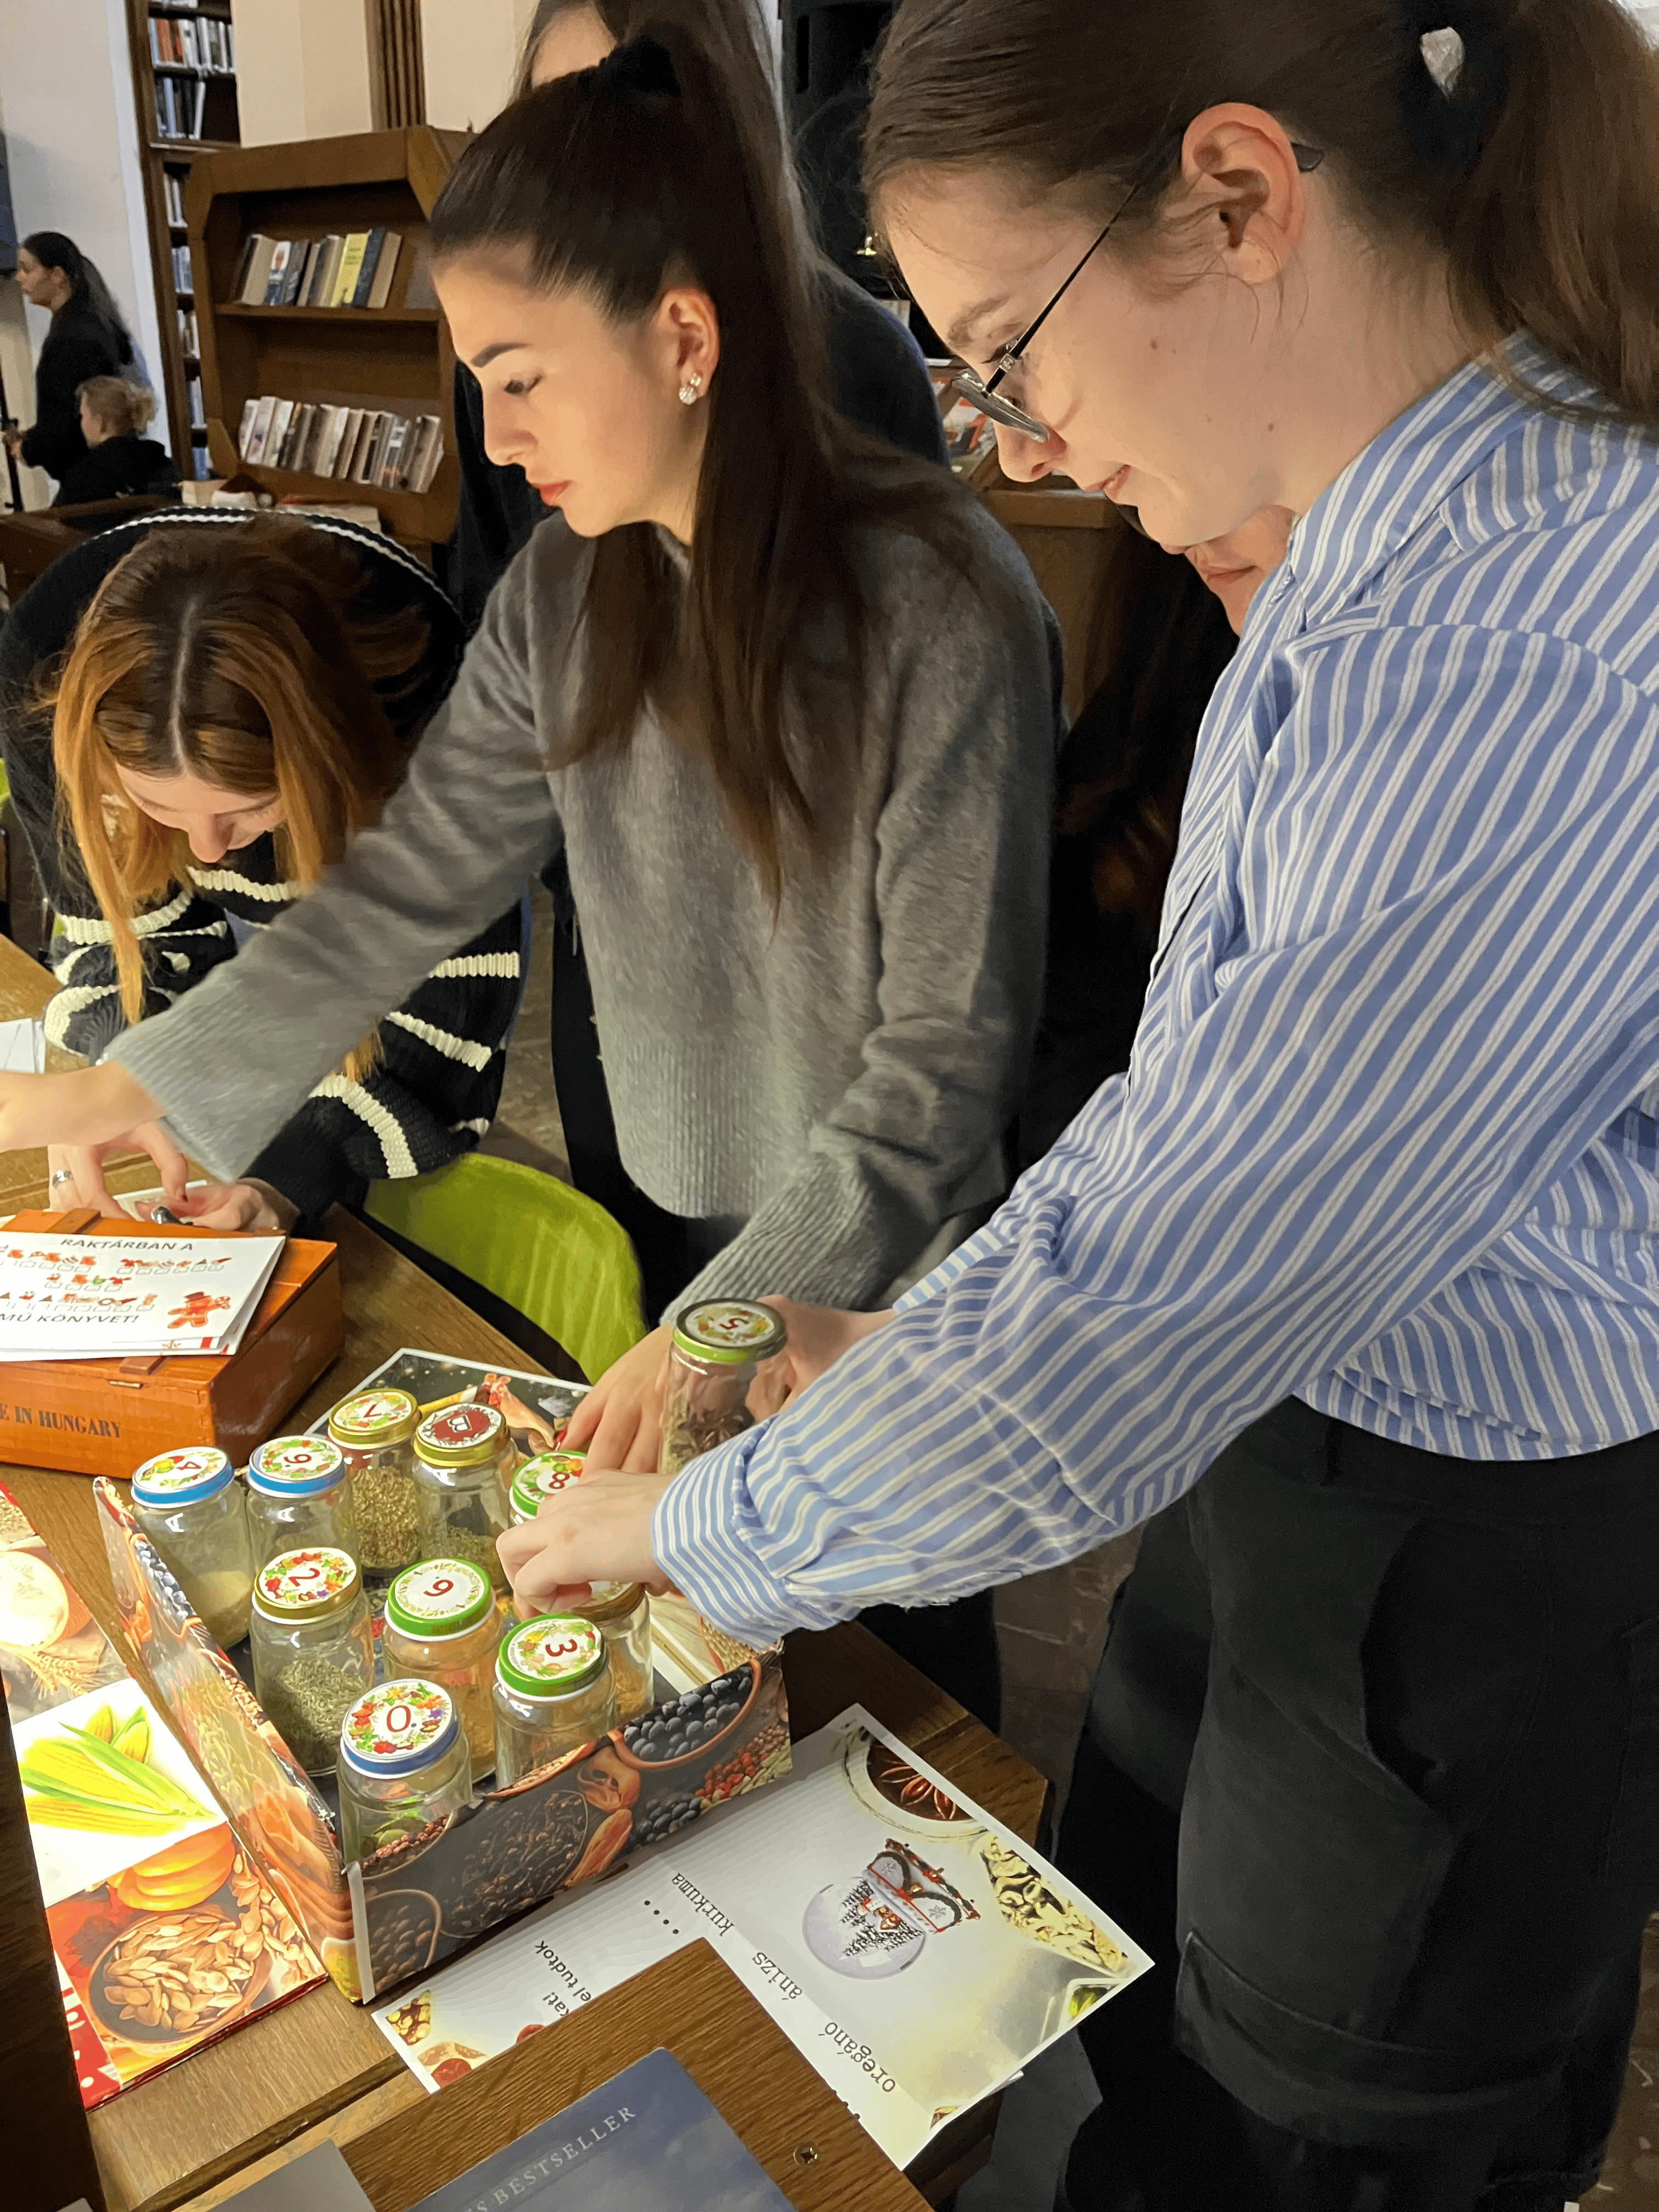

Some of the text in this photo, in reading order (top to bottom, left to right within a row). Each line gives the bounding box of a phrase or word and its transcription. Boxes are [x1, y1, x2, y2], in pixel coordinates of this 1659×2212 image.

[61, 1239, 176, 1250] RAKTÁRBAN
[14, 1405, 32, 1425] IN
[38, 1410, 121, 1438] HUNGARY
[447, 1413, 472, 1433] B
[176, 1459, 201, 1471] 4
[548, 1472, 570, 1489] 8
[289, 1567, 320, 1587] 2
[545, 1638, 578, 1657] 3
[534, 1940, 578, 1989] tudtok
[672, 1873, 896, 2092] oregánó ánizs kurkuma
[494, 2107, 636, 2205] BESTSELLER
